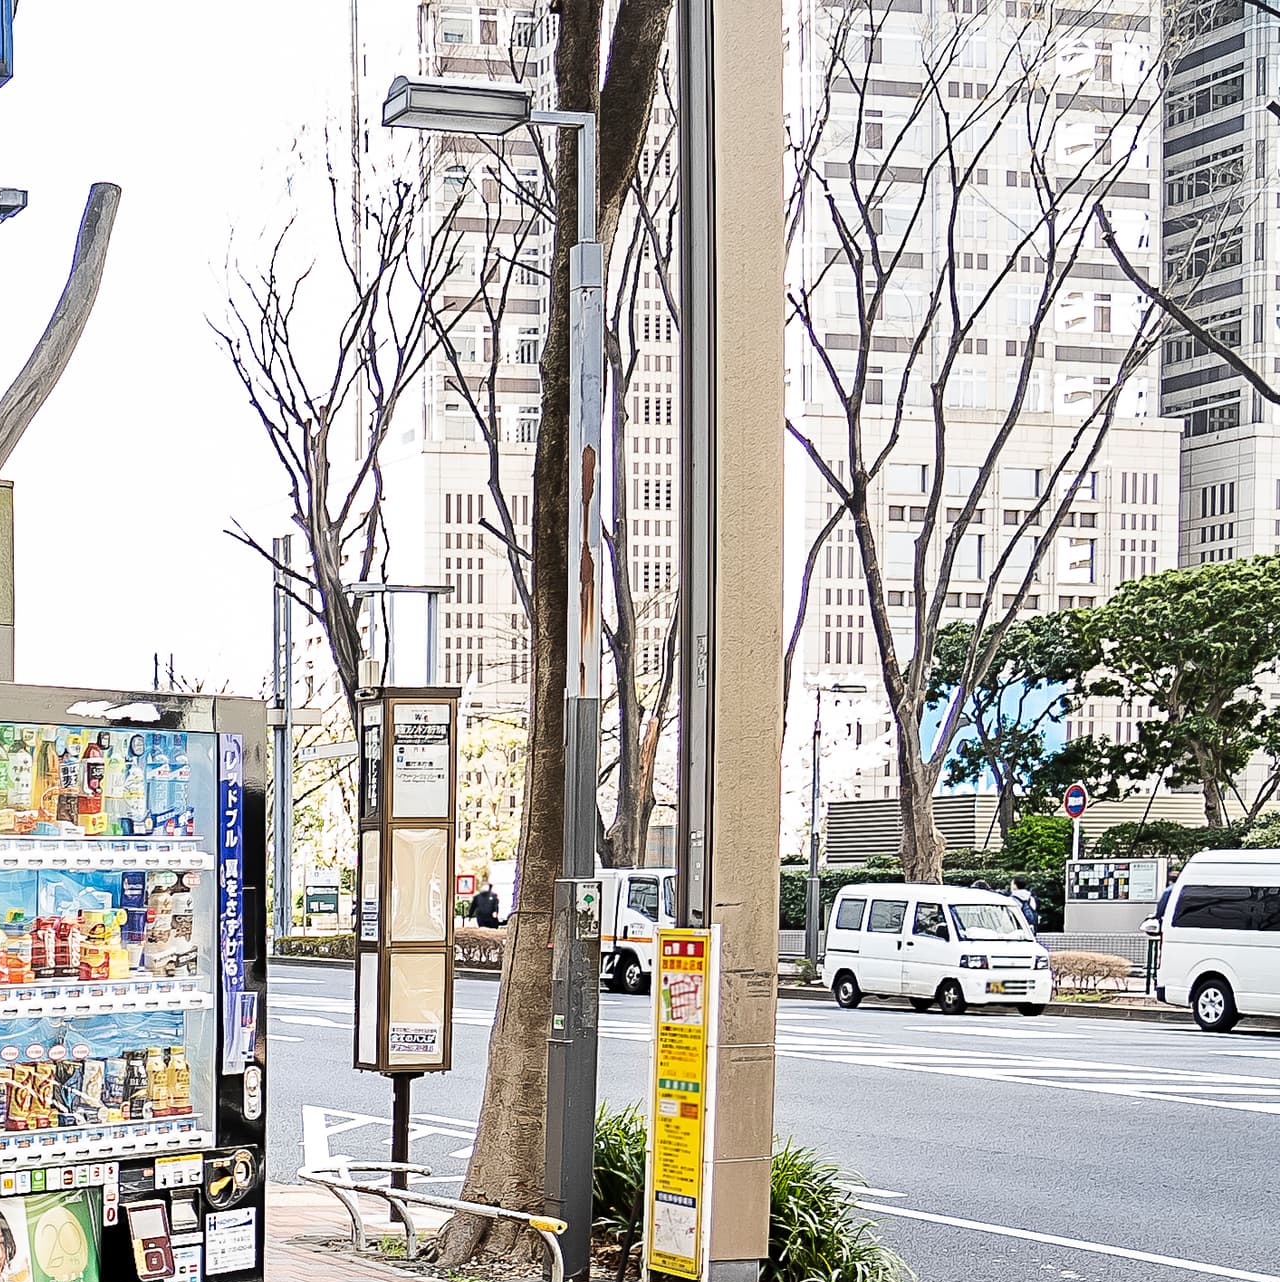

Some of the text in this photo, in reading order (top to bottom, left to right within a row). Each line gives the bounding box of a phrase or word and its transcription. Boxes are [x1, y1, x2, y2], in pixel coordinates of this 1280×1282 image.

[225, 751, 239, 849] レッドブル
